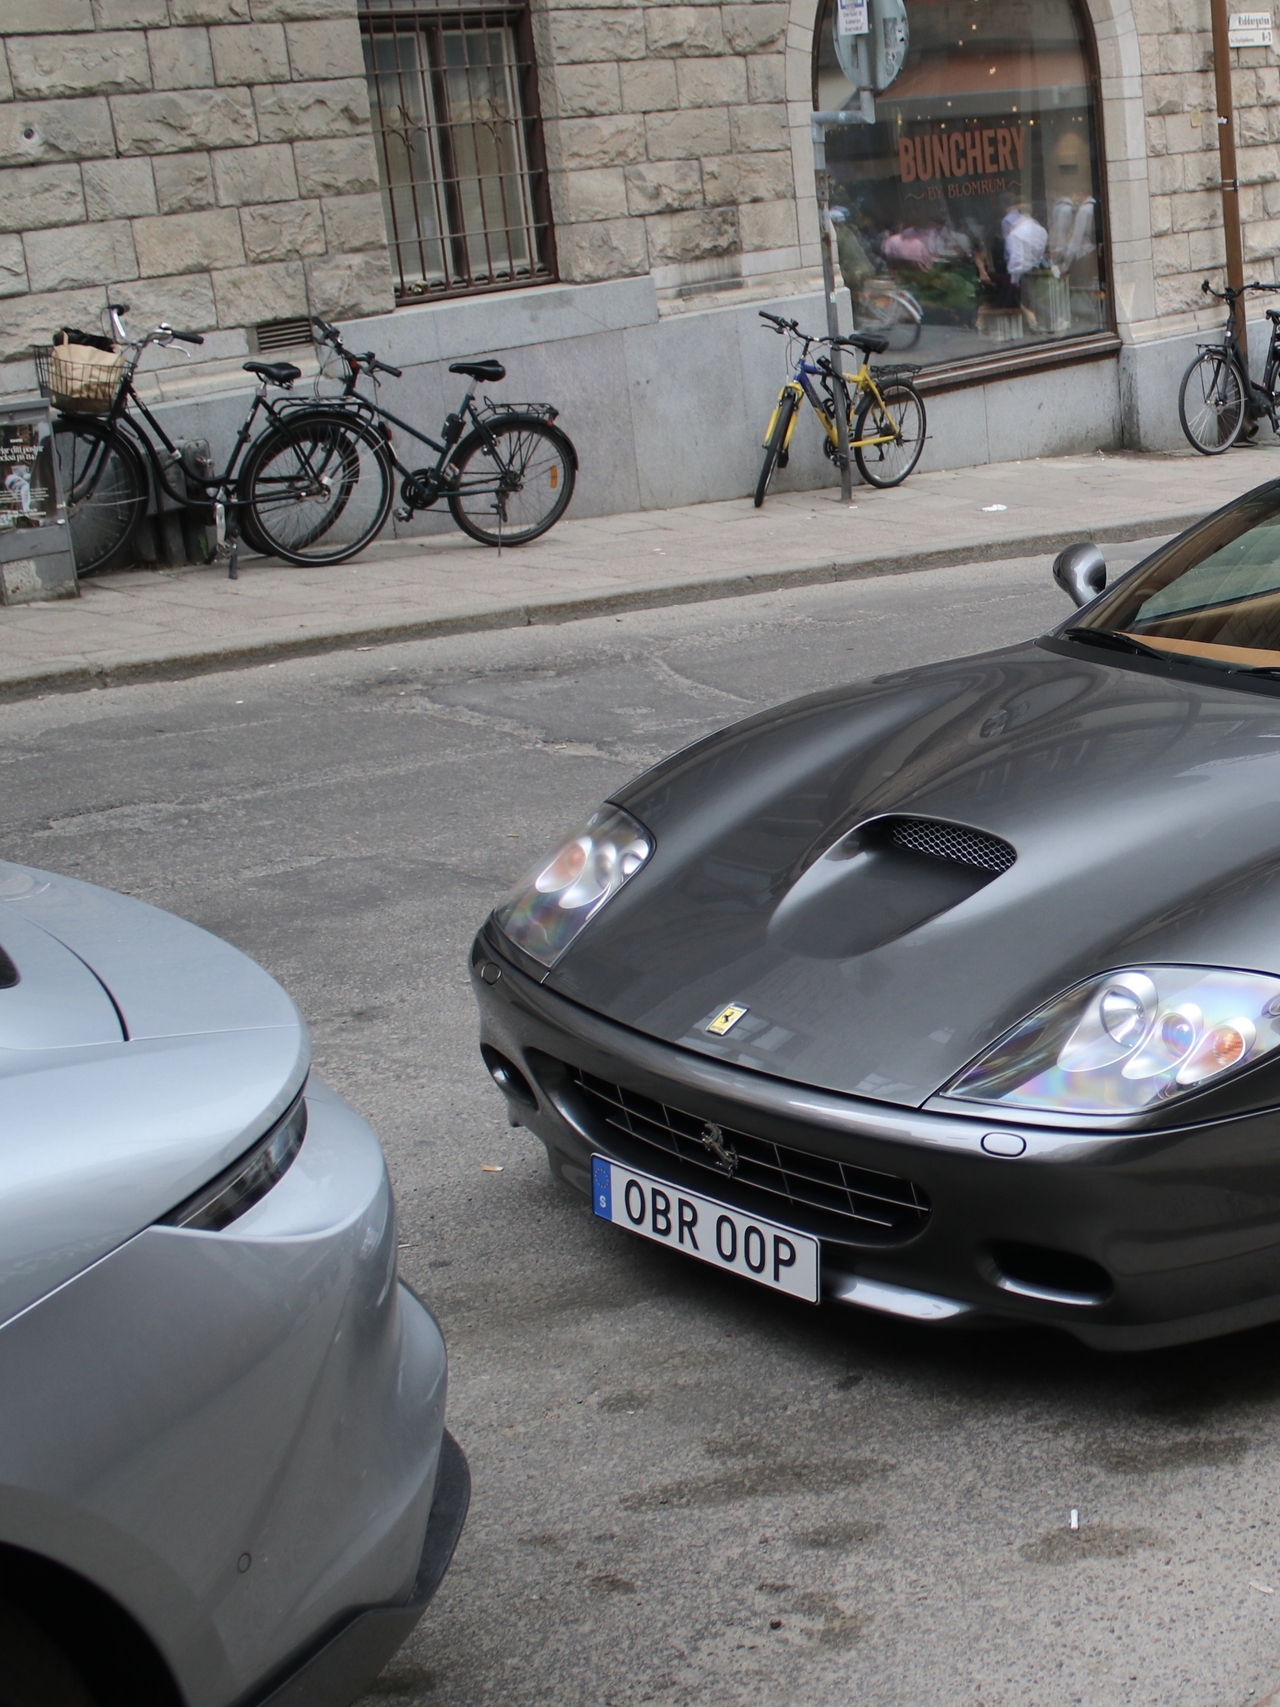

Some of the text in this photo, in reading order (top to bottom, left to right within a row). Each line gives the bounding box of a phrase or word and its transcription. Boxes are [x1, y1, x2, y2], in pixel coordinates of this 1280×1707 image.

[898, 126, 1026, 183] BUNCHERY
[927, 178, 1006, 201] BY BLOMRUM
[599, 1195, 607, 1209] S
[624, 1179, 700, 1251] OBR
